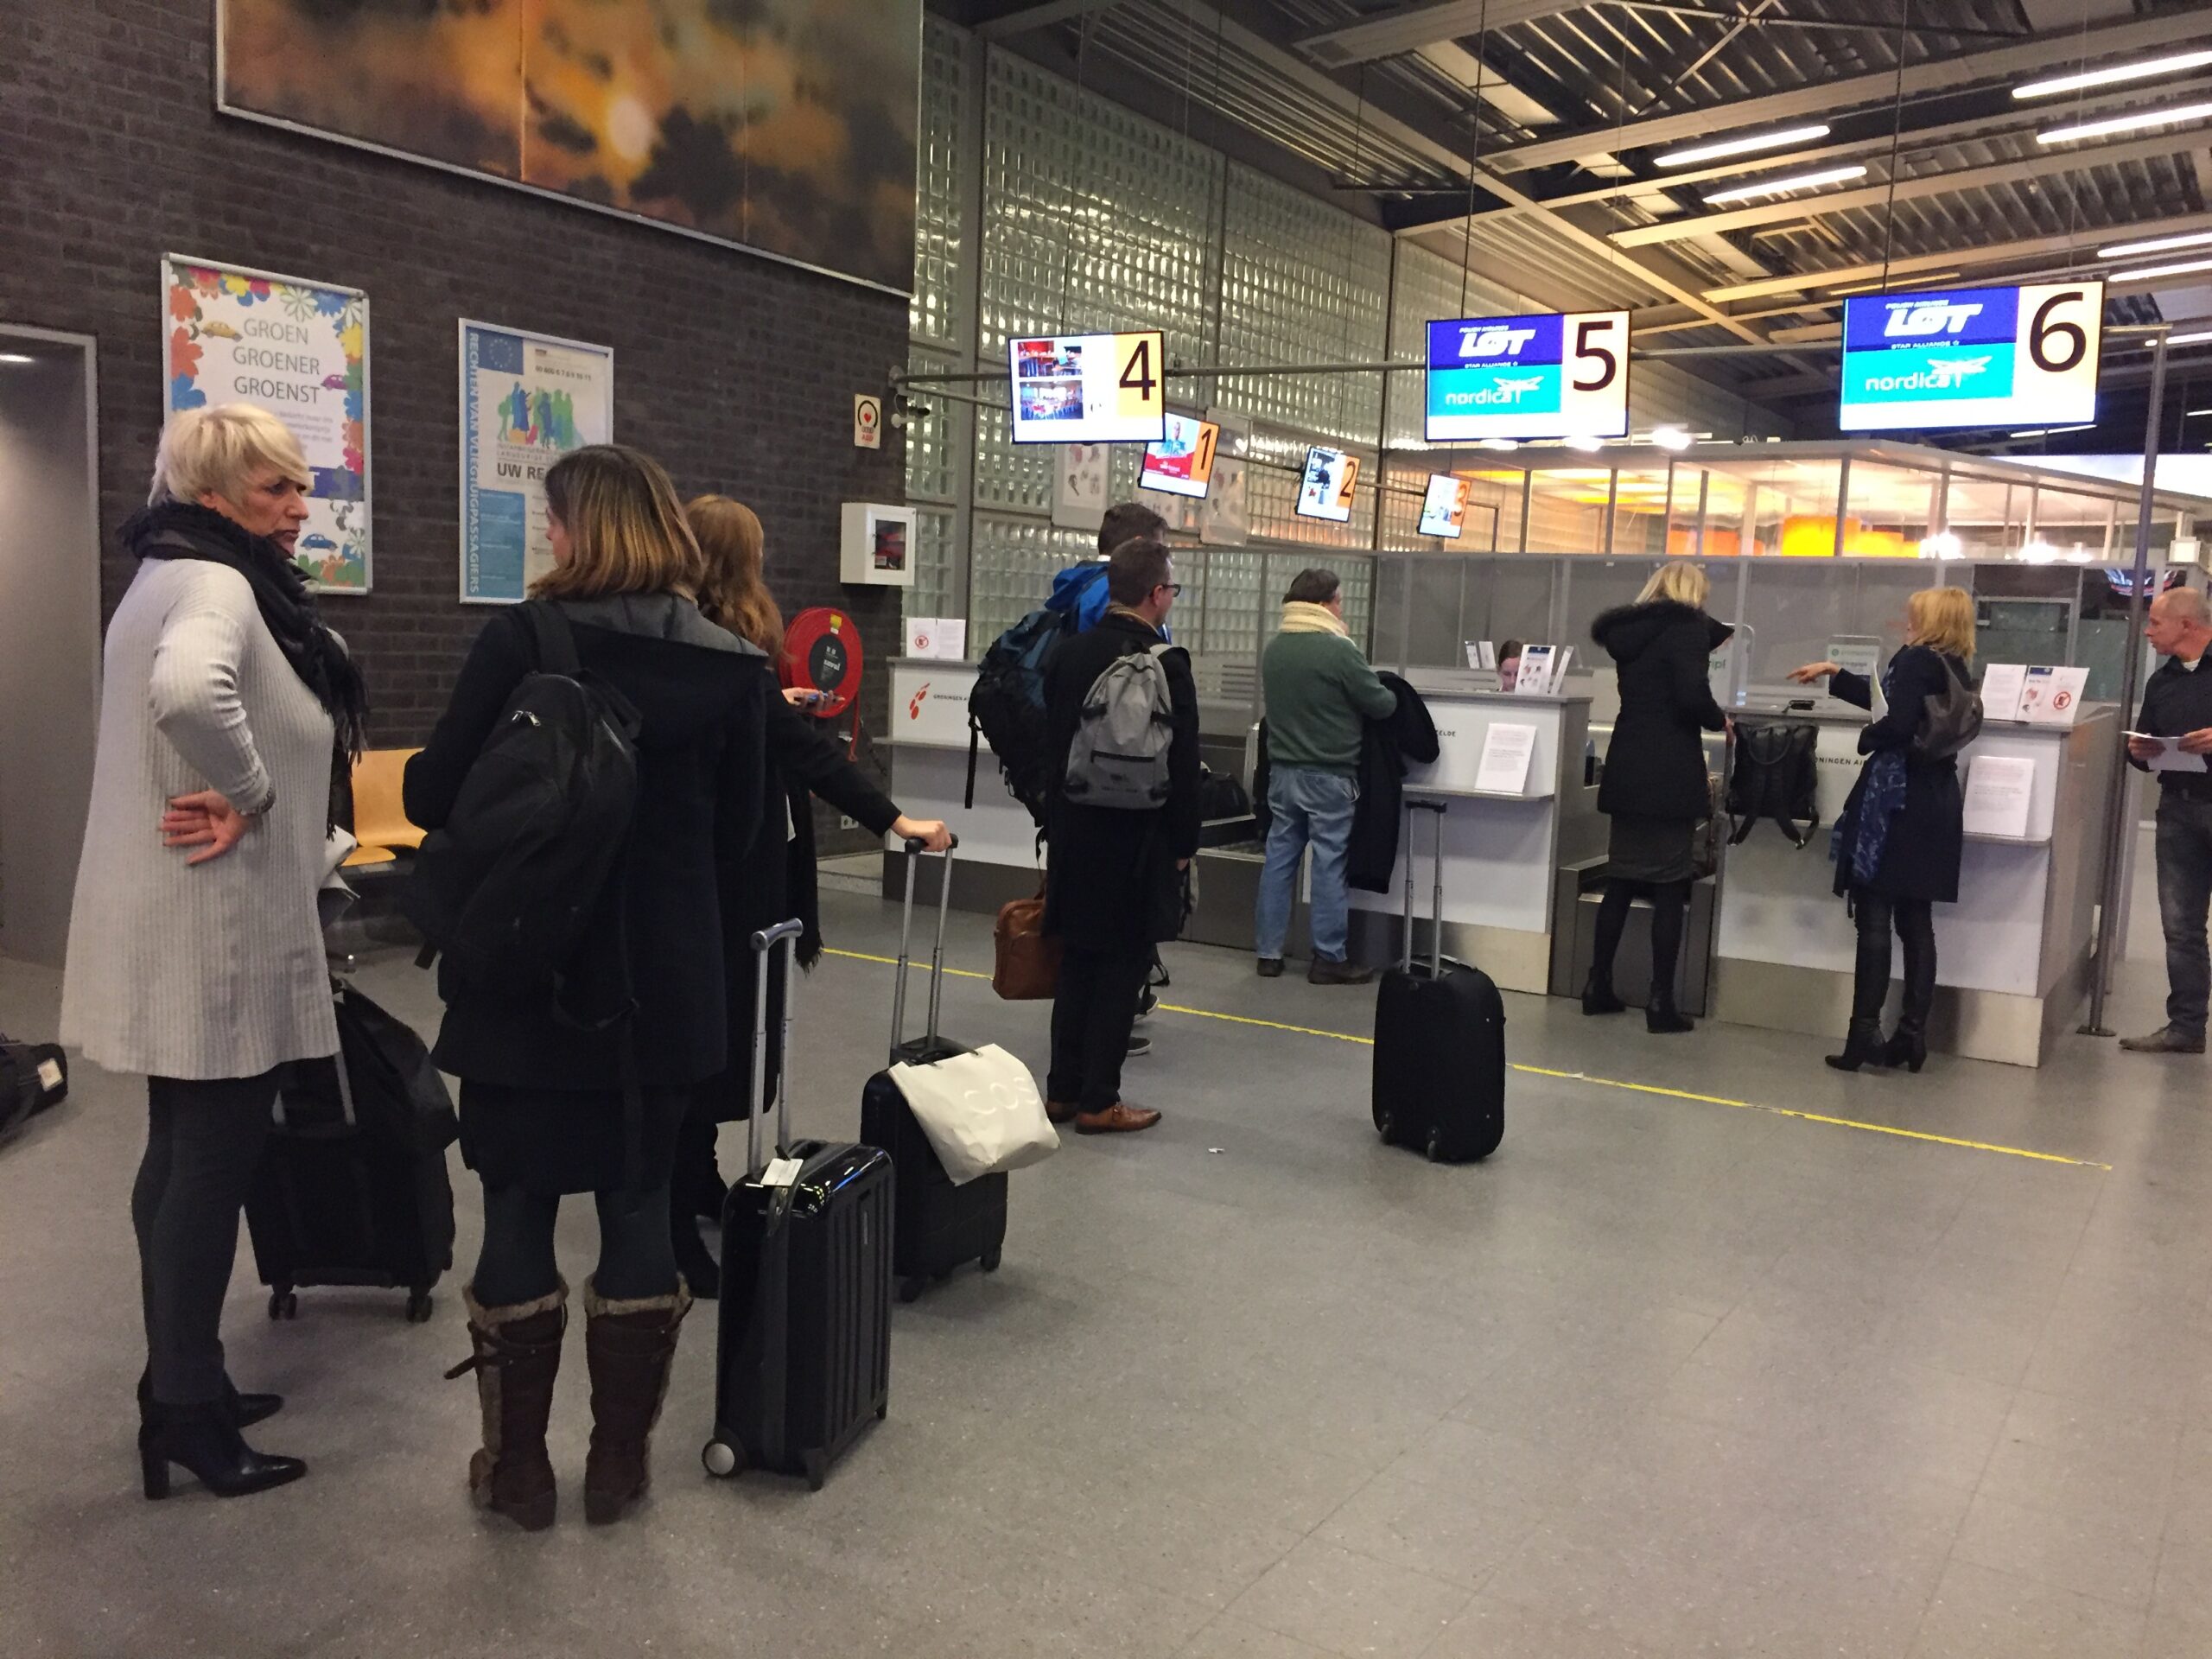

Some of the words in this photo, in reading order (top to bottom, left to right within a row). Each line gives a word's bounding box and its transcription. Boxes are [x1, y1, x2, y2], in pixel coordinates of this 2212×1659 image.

[243, 317, 308, 345] GROEN
[1884, 303, 1983, 337] LOT
[2030, 292, 2086, 372] 6
[1459, 329, 1536, 358] LOT
[1573, 321, 1616, 391] 5
[232, 346, 321, 375] GROENER
[1119, 340, 1157, 401] 4
[233, 376, 321, 404] GROENST
[1445, 388, 1512, 405] nordica
[1865, 372, 1951, 391] nordica
[1200, 429, 1211, 470] 1
[497, 462, 522, 478] UW
[527, 466, 544, 481] RE
[1340, 461, 1356, 498] 2
[1454, 484, 1467, 517] 3
[963, 1076, 1039, 1115] COS
